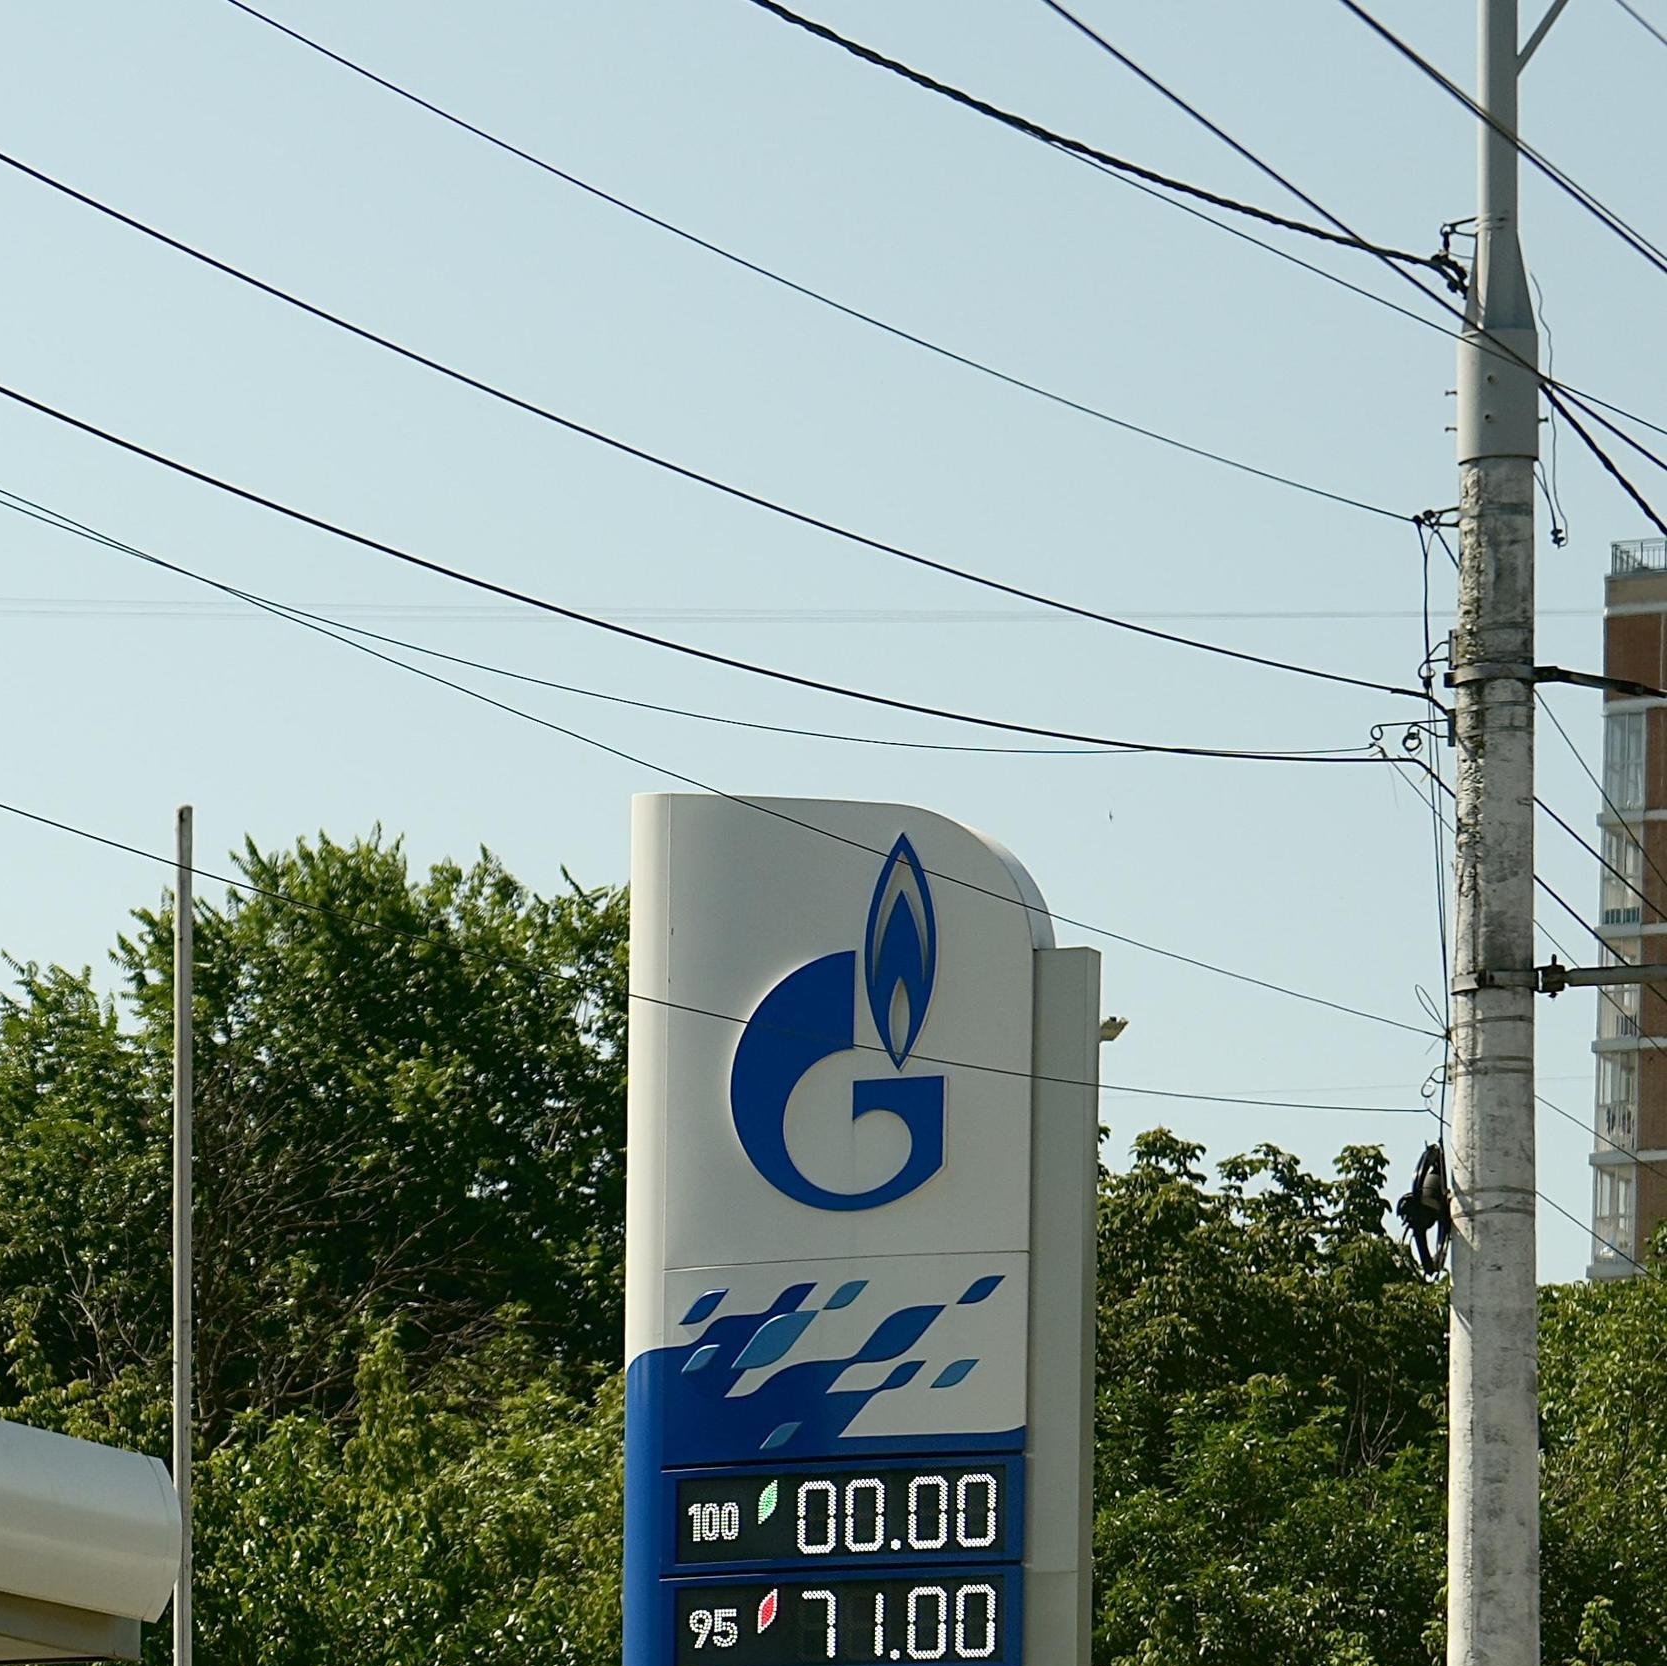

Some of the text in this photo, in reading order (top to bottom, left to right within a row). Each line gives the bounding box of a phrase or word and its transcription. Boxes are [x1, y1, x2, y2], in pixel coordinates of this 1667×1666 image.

[688, 1473, 997, 1554] 100 00.00
[688, 1584, 996, 1660] 95 71.00
